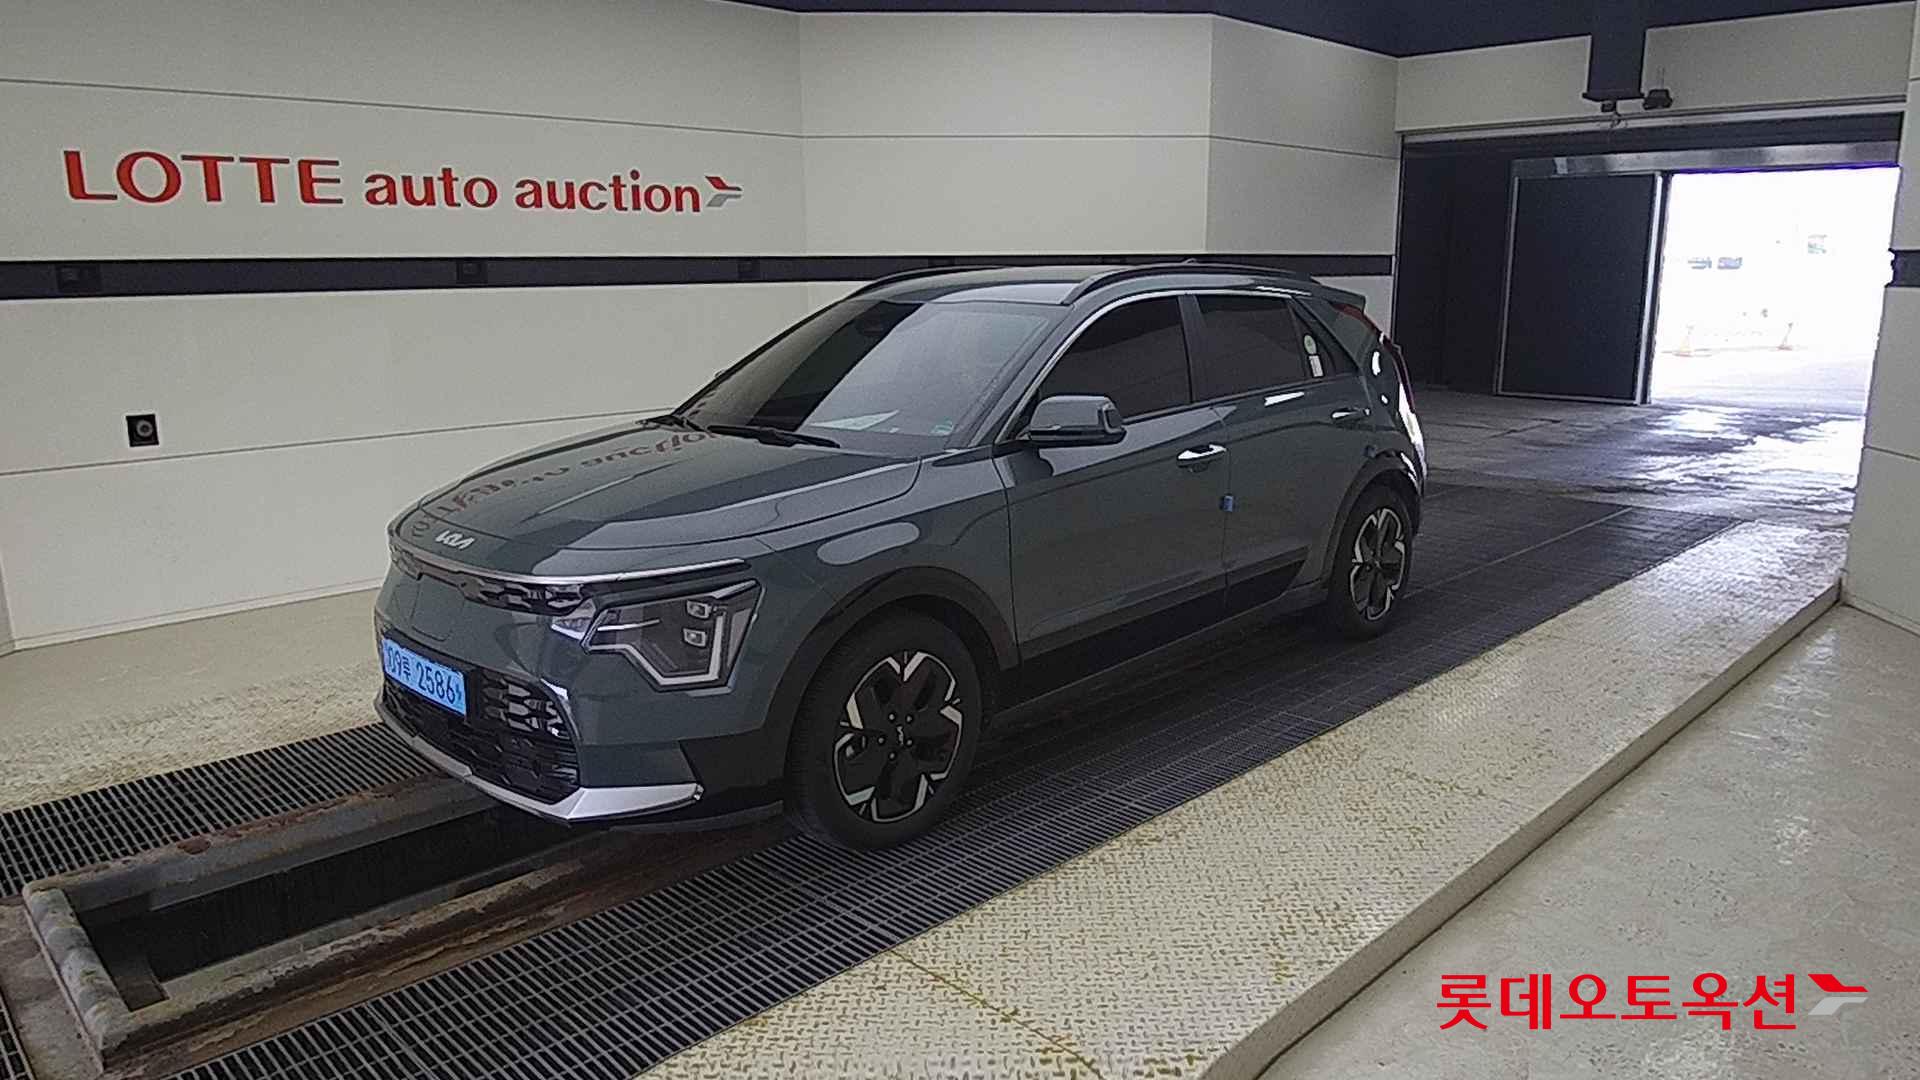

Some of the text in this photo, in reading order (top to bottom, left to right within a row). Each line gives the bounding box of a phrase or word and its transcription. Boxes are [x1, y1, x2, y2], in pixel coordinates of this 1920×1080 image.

[63, 149, 702, 213] LOTTE auto auction
[416, 662, 456, 704] 2586
